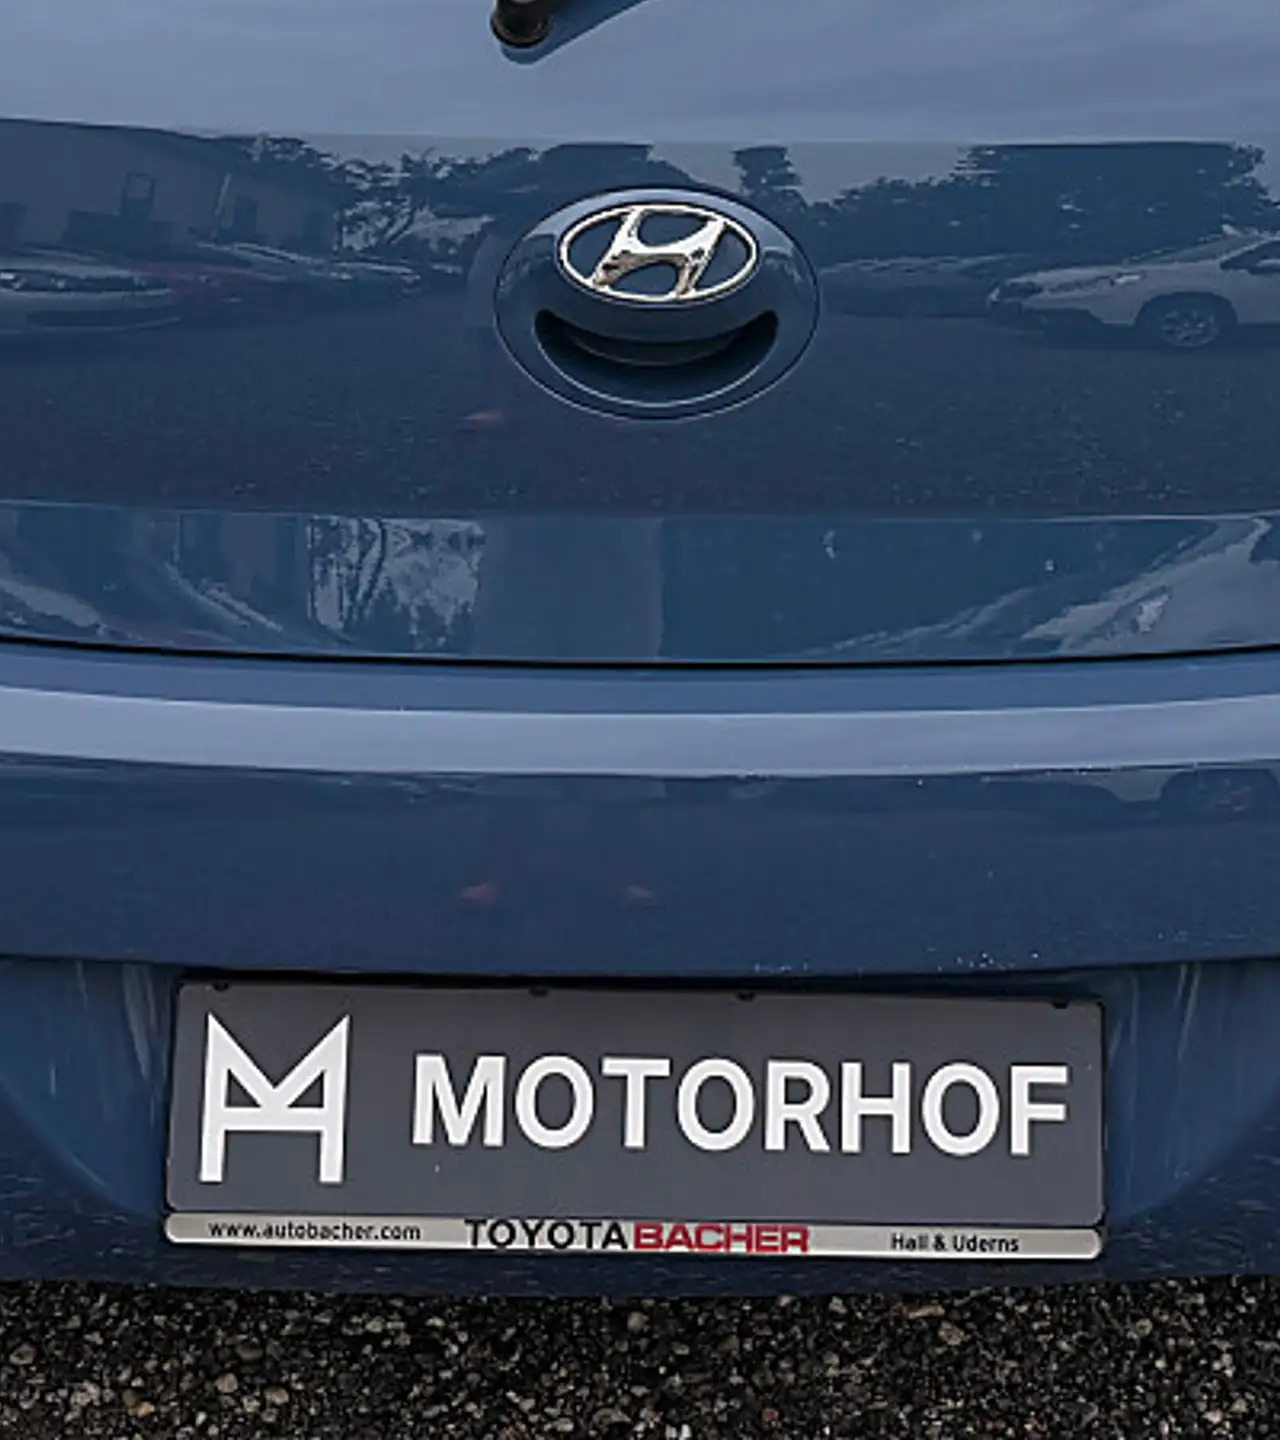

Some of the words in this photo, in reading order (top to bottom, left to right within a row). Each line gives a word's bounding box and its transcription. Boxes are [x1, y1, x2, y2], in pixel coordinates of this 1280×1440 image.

[411, 1052, 1070, 1157] MOTORHOF
[207, 1220, 422, 1242] www.autobacher.com
[932, 1233, 946, 1253] &
